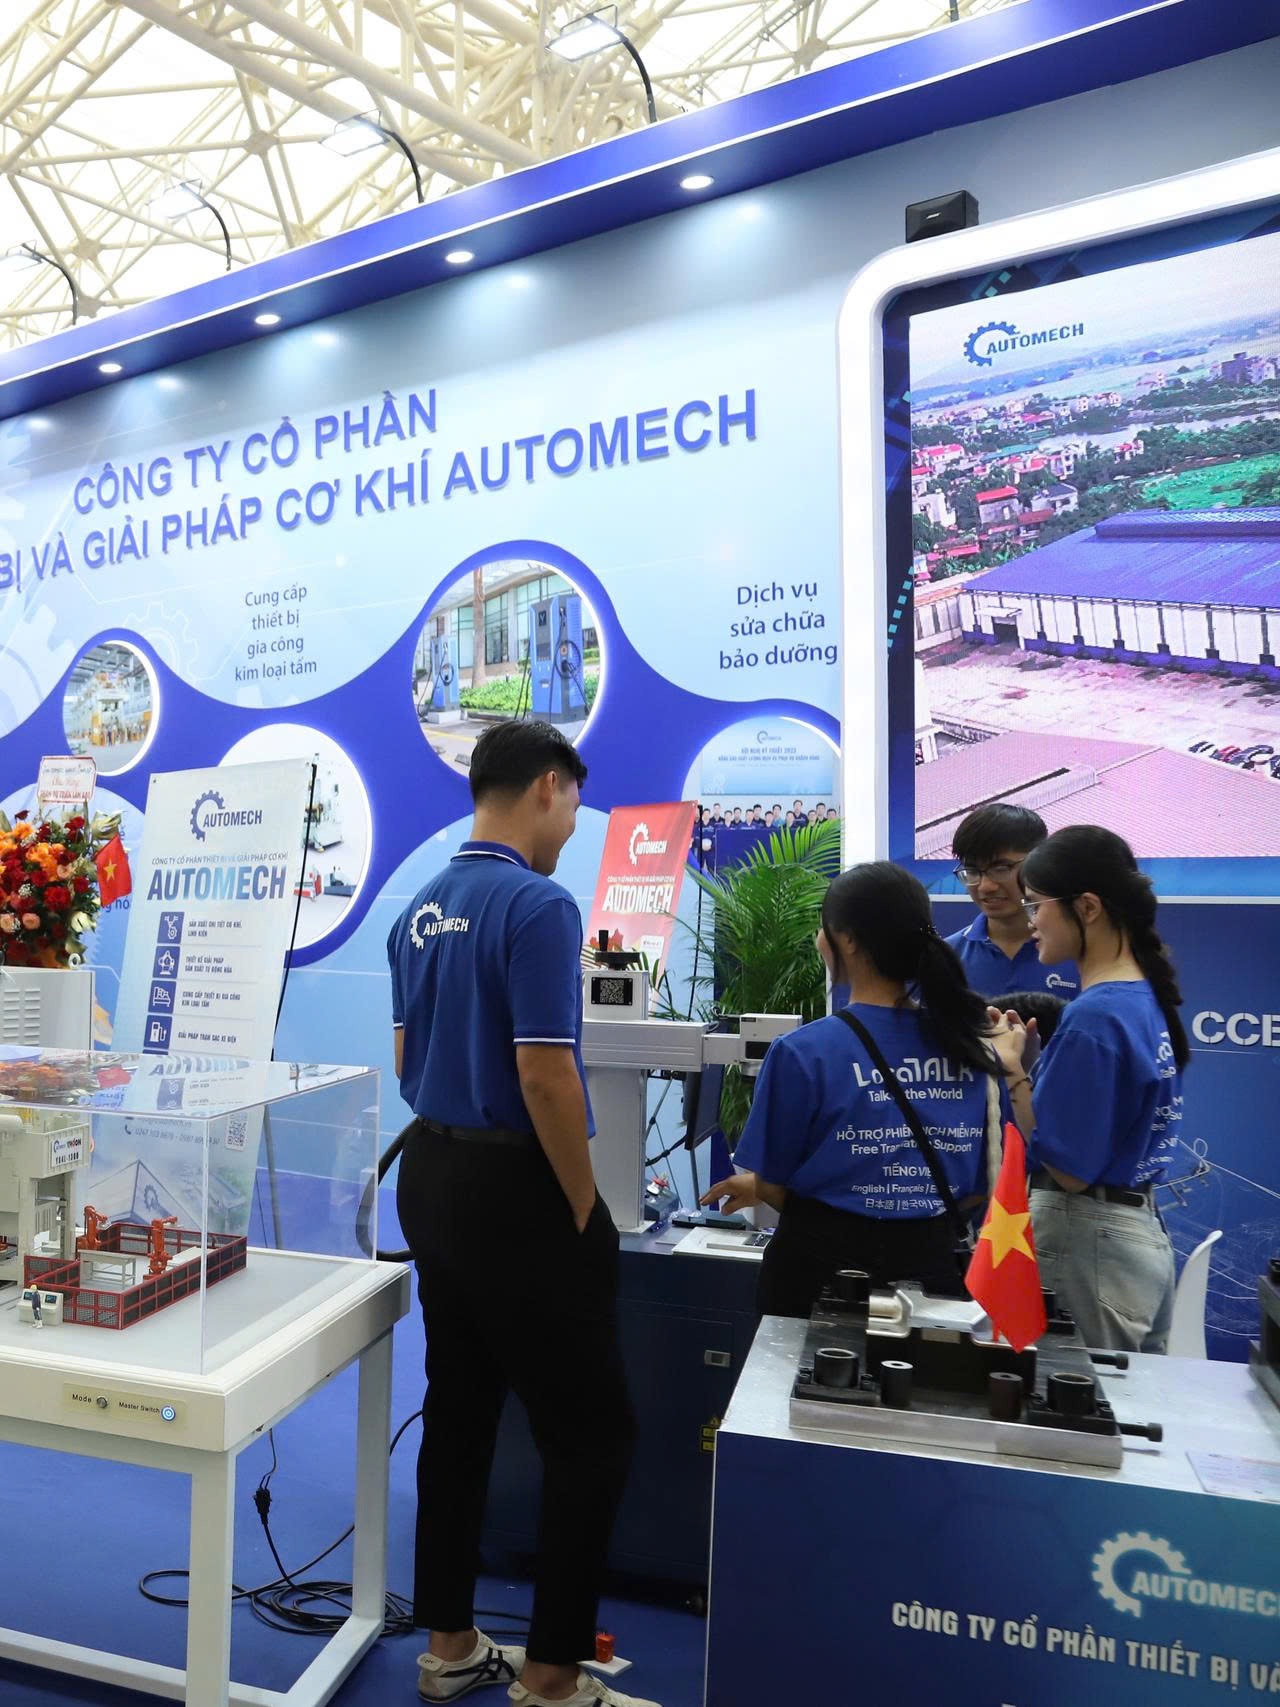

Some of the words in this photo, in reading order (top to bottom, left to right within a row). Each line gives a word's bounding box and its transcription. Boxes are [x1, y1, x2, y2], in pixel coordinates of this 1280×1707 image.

[987, 322, 1085, 356] AUTOMECH
[73, 456, 173, 515] CÔNG
[183, 440, 231, 489] TY
[242, 415, 301, 476] CỔ
[315, 388, 438, 460] PHẦN
[31, 531, 74, 581] VÀ
[83, 513, 151, 570] GIẢI
[161, 496, 263, 555] PHÁP
[275, 477, 343, 531] CƠ
[355, 448, 432, 516] KHÍ
[443, 388, 758, 500] AUTOMECH
[245, 590, 281, 611] Cung
[282, 583, 308, 605] cấp
[736, 583, 785, 609] Dịch
[791, 583, 819, 603] vụ
[251, 608, 284, 631] thiết
[287, 608, 301, 630] bị
[730, 617, 766, 638] sửa
[772, 611, 827, 634] chữa
[247, 640, 268, 659] gia
[270, 633, 305, 656] công
[719, 646, 760, 671] bảo
[765, 641, 839, 667] dưỡng
[234, 663, 259, 682] kim
[262, 659, 287, 681] loại
[290, 656, 318, 676] tấm
[203, 810, 263, 829] AUTOMECH
[635, 840, 668, 855] AUTOMECH
[147, 865, 288, 901] AUTOMECH
[602, 885, 674, 913] AUTOMECH
[422, 917, 470, 937] AUTMECH
[852, 1057, 975, 1088] LoaTALK
[868, 1090, 892, 1102] Talk
[905, 1089, 927, 1100] the
[928, 1087, 963, 1100] World
[836, 1124, 856, 1141] HỖ
[857, 1128, 884, 1142] TRỢ
[969, 1127, 984, 1138] PH
[851, 1143, 879, 1155] Free
[933, 1139, 973, 1154] Support
[918, 1165, 932, 1179] VIỆ
[851, 1184, 885, 1195] English
[891, 1184, 925, 1194] Français
[72, 1393, 92, 1405] Mode
[119, 1402, 139, 1410] Master
[140, 1405, 160, 1413] Switch
[1131, 1571, 1280, 1617] AUTOMEC
[891, 1600, 960, 1637] CÔNG
[967, 1614, 996, 1642] TY
[1003, 1614, 1037, 1650] CỔ
[1046, 1624, 1117, 1664] PHẦN
[1125, 1640, 1201, 1678] THIẾT
[1210, 1655, 1241, 1690] BỊ
